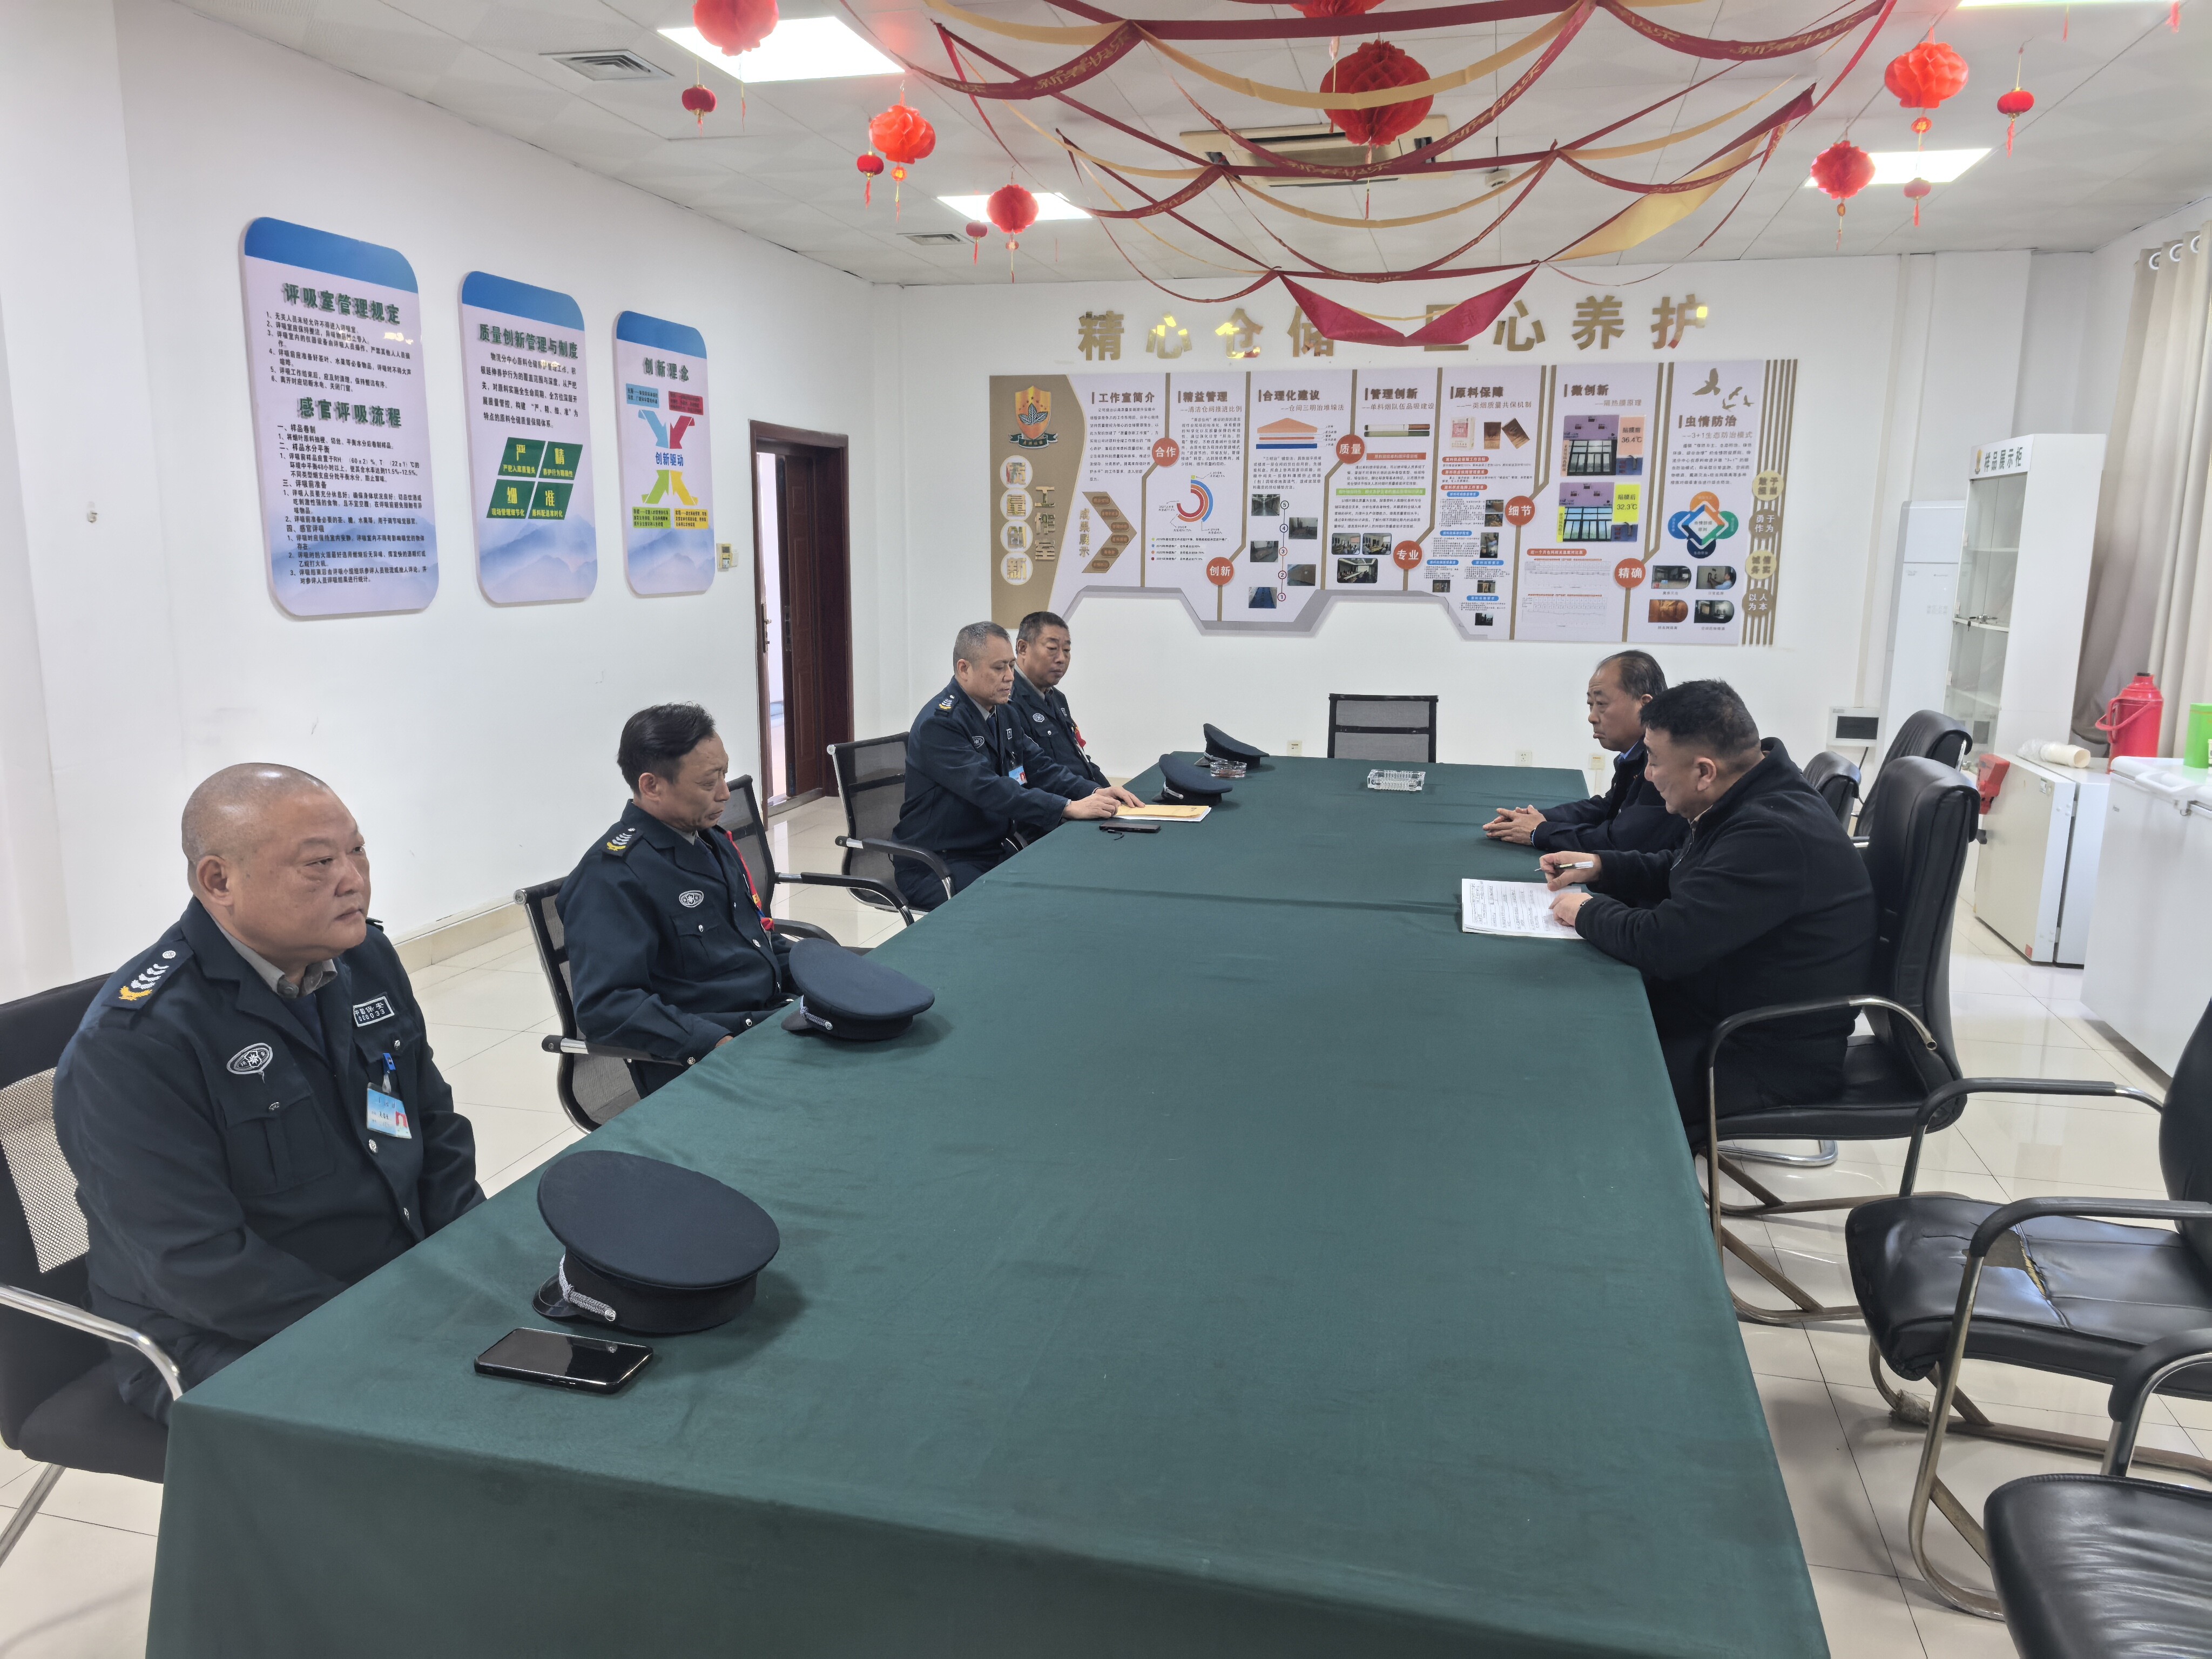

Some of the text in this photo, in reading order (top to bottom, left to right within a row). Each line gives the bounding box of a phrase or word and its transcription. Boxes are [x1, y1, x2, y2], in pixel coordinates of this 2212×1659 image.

[282, 282, 400, 325] 评吸室管理规定
[479, 323, 578, 359] 质量创新管理与制度
[643, 357, 689, 382] 创新理念
[1263, 390, 1320, 401] 合理化建议
[1371, 388, 1418, 400] 管理创新
[1455, 386, 1503, 397] 原料保障
[1571, 384, 1609, 396] 微创新
[1098, 392, 1155, 403] 工作室简介
[1183, 391, 1228, 402] 精益管理
[298, 397, 401, 428] 感官评吸流程
[1685, 415, 1737, 427] 虫情防治
[279, 443, 329, 454] 二、样品水分平衡
[516, 444, 525, 461] 严
[1155, 447, 1176, 457] 合作
[1339, 443, 1361, 454] 质量
[655, 451, 684, 466] 创新驱动
[1984, 447, 2022, 473] 样品展示柜
[283, 480, 327, 489] 三、评吸前准备
[507, 487, 517, 504] 细
[545, 490, 555, 507] 准
[1508, 505, 1532, 516] 细节
[1006, 462, 1026, 580] 质量创新
[1035, 486, 1056, 561] 工作室
[1756, 515, 1775, 523] 勇于
[1755, 524, 1774, 532] 作为
[1397, 549, 1419, 560] 专业
[1209, 565, 1231, 577] 创新
[1618, 567, 1642, 578] 精确
[1749, 594, 1768, 602] 以人
[1748, 602, 1768, 611] 为本
[354, 1002, 384, 1016] 中国保安
[359, 1009, 385, 1021] 000033
